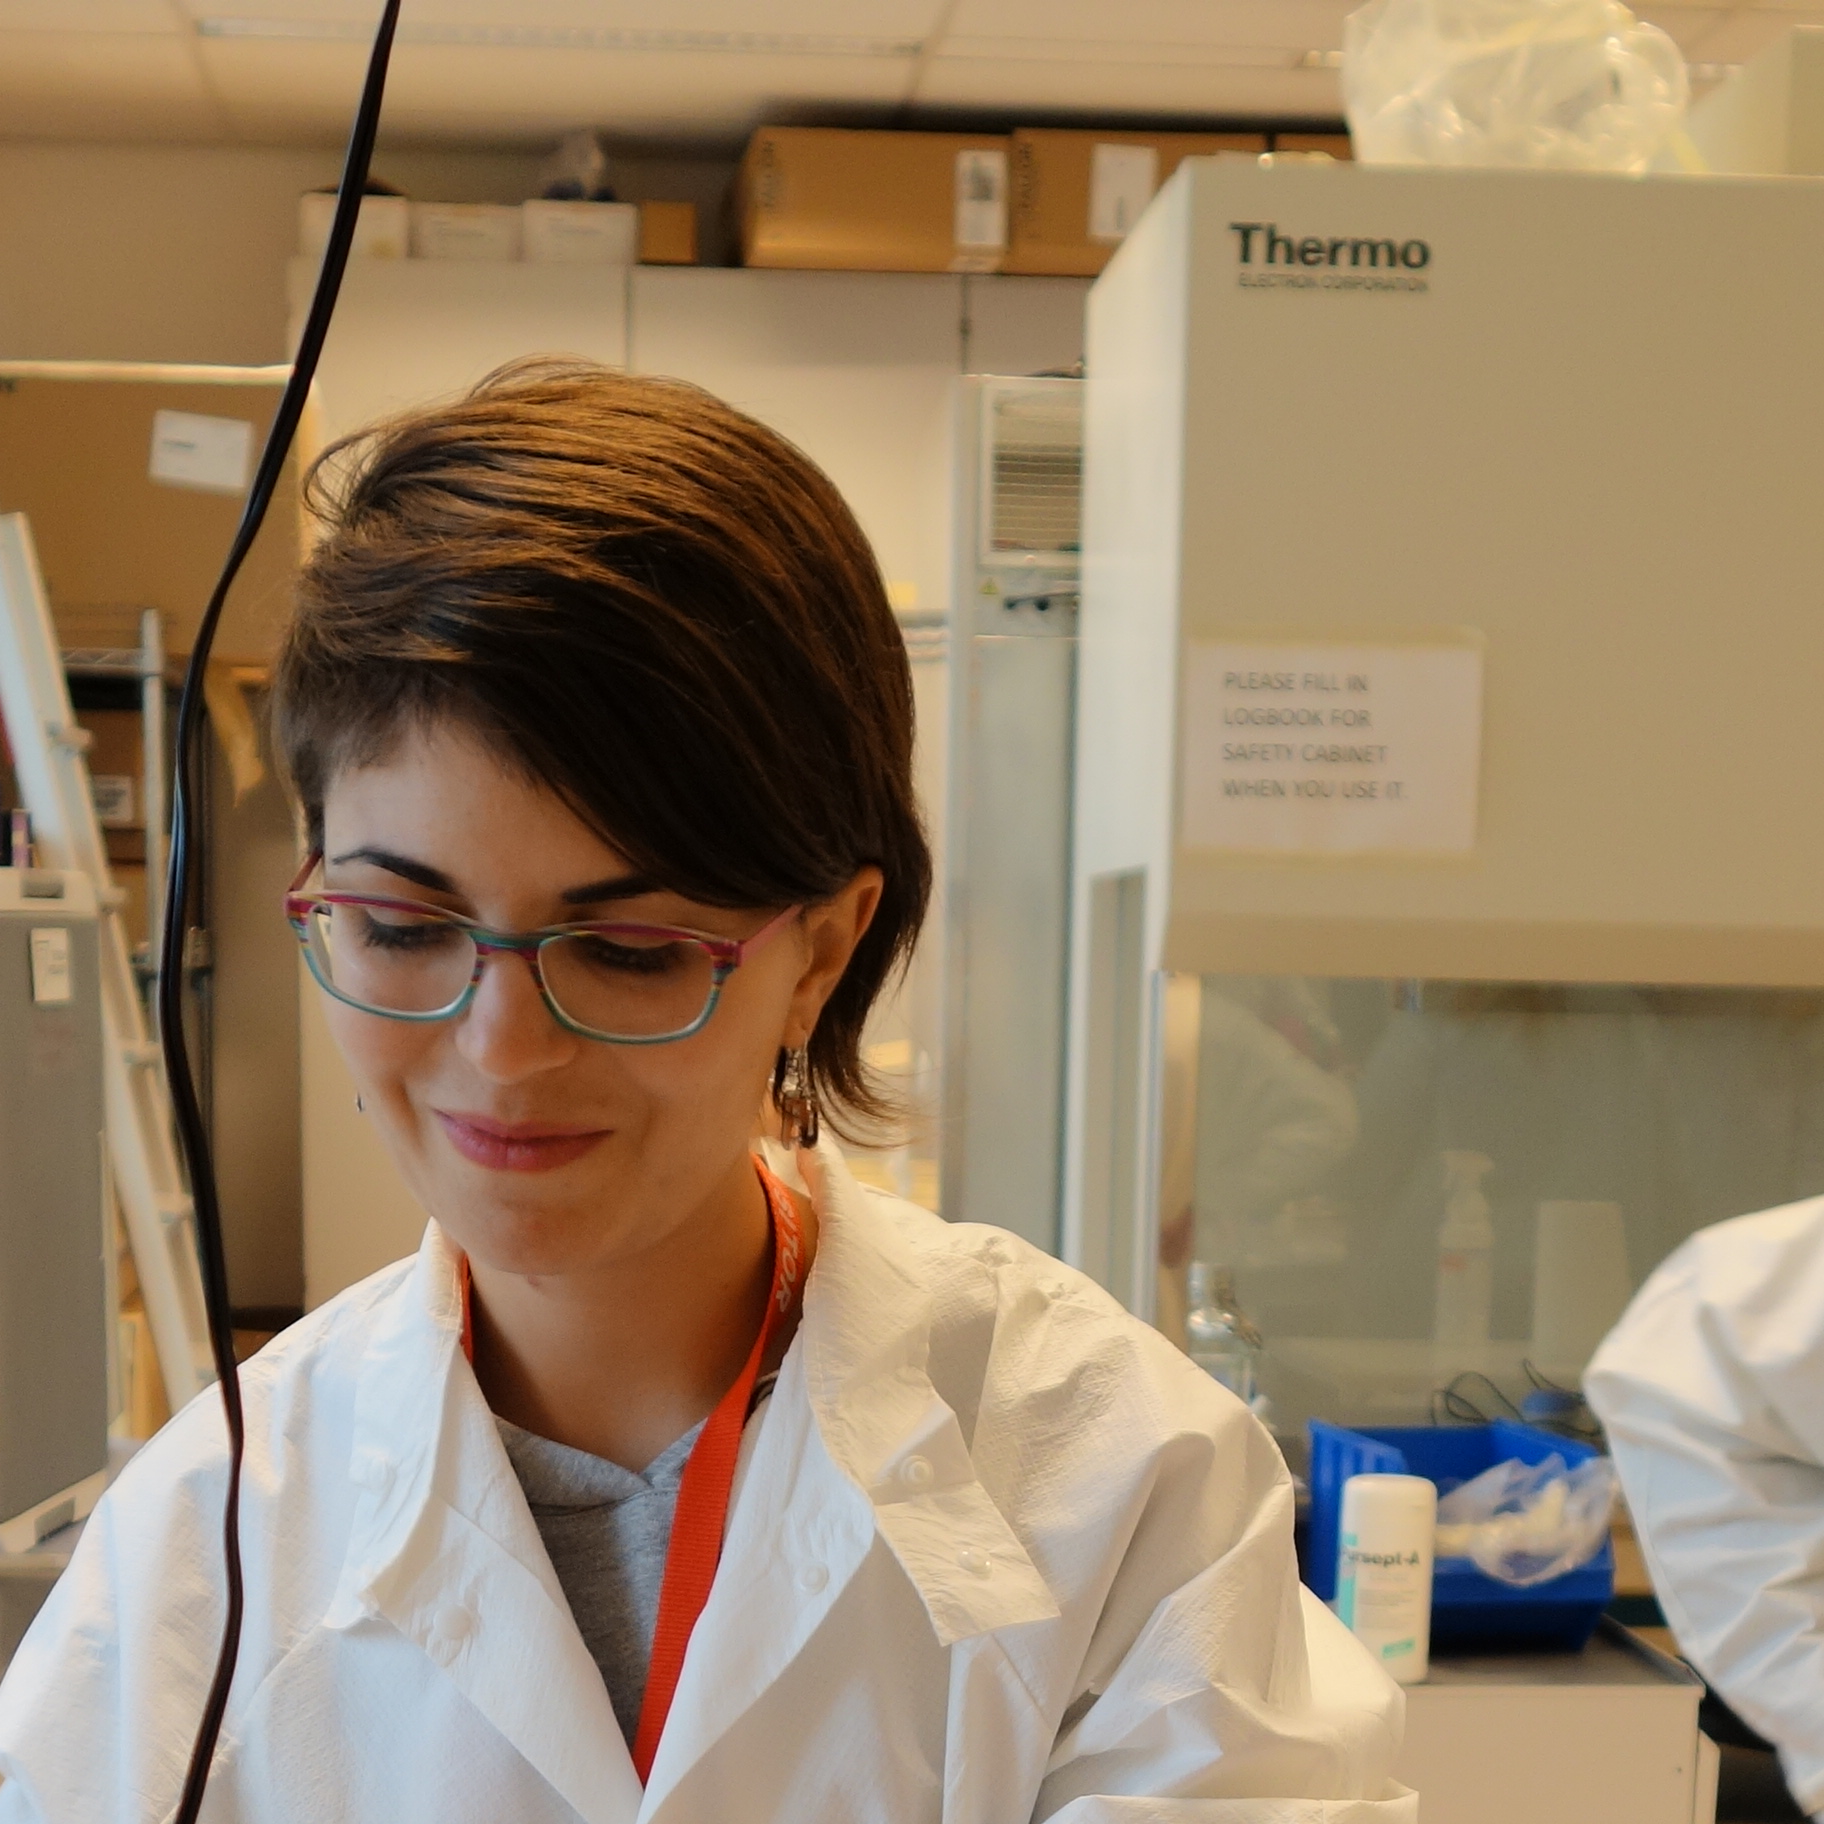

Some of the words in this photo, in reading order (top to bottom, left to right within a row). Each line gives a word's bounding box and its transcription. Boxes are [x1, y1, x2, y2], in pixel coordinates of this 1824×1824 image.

[1231, 222, 1432, 269] Thermo
[1224, 671, 1296, 691] PLEASE
[1302, 673, 1340, 691] FILL
[1347, 674, 1368, 692] IN
[1223, 707, 1324, 726] LOGBOOK
[1331, 709, 1372, 728] FOR
[1222, 742, 1294, 762] SAFETY
[1301, 744, 1389, 764] CABINET
[1221, 778, 1286, 798] WHEN
[1292, 779, 1334, 799] YOU
[1342, 780, 1378, 800] USE
